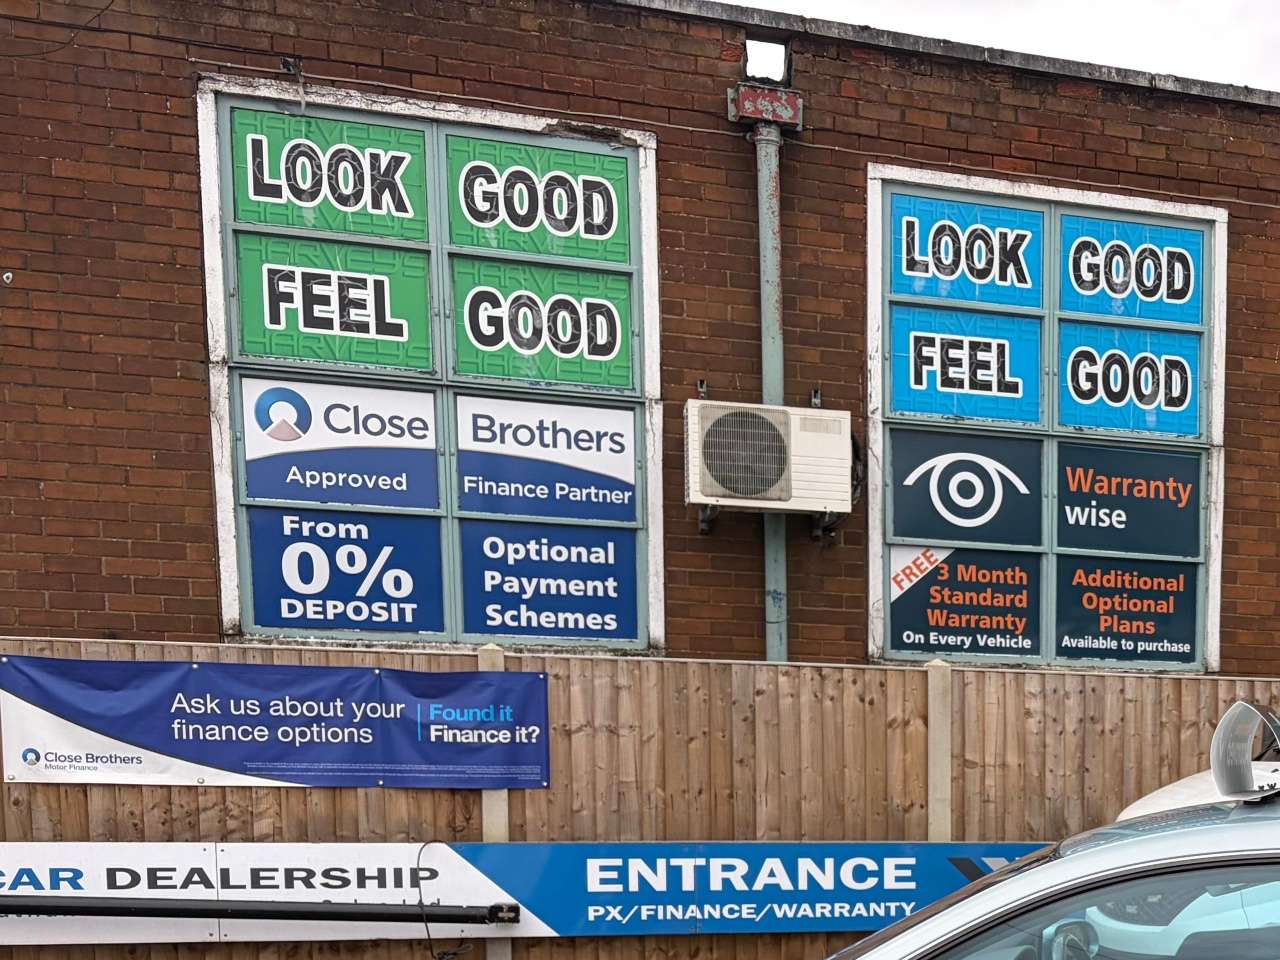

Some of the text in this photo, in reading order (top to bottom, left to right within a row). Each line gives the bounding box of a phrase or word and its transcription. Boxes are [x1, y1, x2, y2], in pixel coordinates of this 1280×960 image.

[246, 134, 618, 240] LOOK GOOD
[902, 216, 1032, 288] LOOK
[1069, 236, 1194, 304] GOOD
[262, 263, 621, 360] FEEL GOOD
[910, 331, 1023, 398] FEEL
[1067, 346, 1192, 411] GOOD
[324, 403, 626, 454] Close Brothers
[286, 466, 407, 491] Approved
[464, 477, 632, 504] Finance Partner
[1066, 467, 1192, 508] Warranty
[1065, 501, 1127, 528] wise
[282, 516, 369, 540] From
[483, 536, 615, 565] Optional
[281, 542, 414, 598] 0%
[891, 547, 938, 592] FREE
[938, 563, 1028, 586] 3 Month
[1072, 569, 1184, 592] Additional
[484, 571, 618, 599] Payment
[929, 586, 1027, 608] Standard
[281, 599, 417, 623] DEPOSIT
[1082, 593, 1174, 615] Optional
[486, 604, 618, 631] Schemes
[927, 609, 1026, 635] Warranty
[1099, 615, 1155, 634] Plans
[903, 631, 1032, 649] On Every Vehicle
[1062, 636, 1191, 655] Available to purchase
[170, 692, 405, 723] Ask us about your
[429, 703, 513, 723] Found it
[171, 721, 373, 747] finance options
[430, 724, 540, 744] Finance it?
[44, 752, 143, 765] Close Brothers
[44, 763, 68, 771] Motor
[0, 867, 439, 890] AR DEALERSHIP
[585, 857, 917, 892] ENTRANCE
[587, 902, 916, 924] PX/FINANCE/WARRANTY
